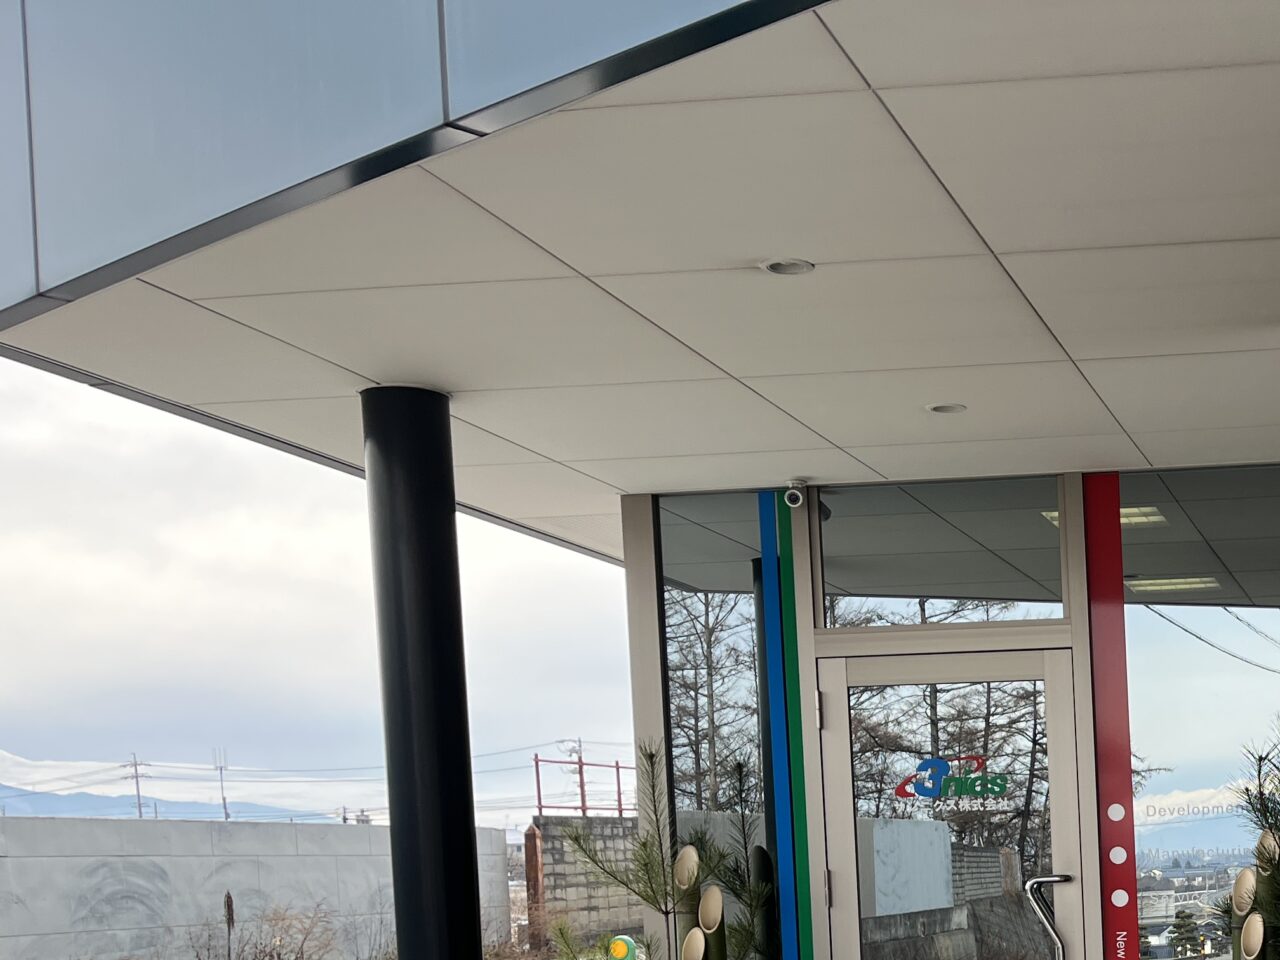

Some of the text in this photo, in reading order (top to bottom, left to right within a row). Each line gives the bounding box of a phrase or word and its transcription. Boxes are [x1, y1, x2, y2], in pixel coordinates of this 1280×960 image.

[1146, 803, 1247, 818] Developmen
[1148, 846, 1255, 860] Manufacturin
[1116, 931, 1127, 958] New
